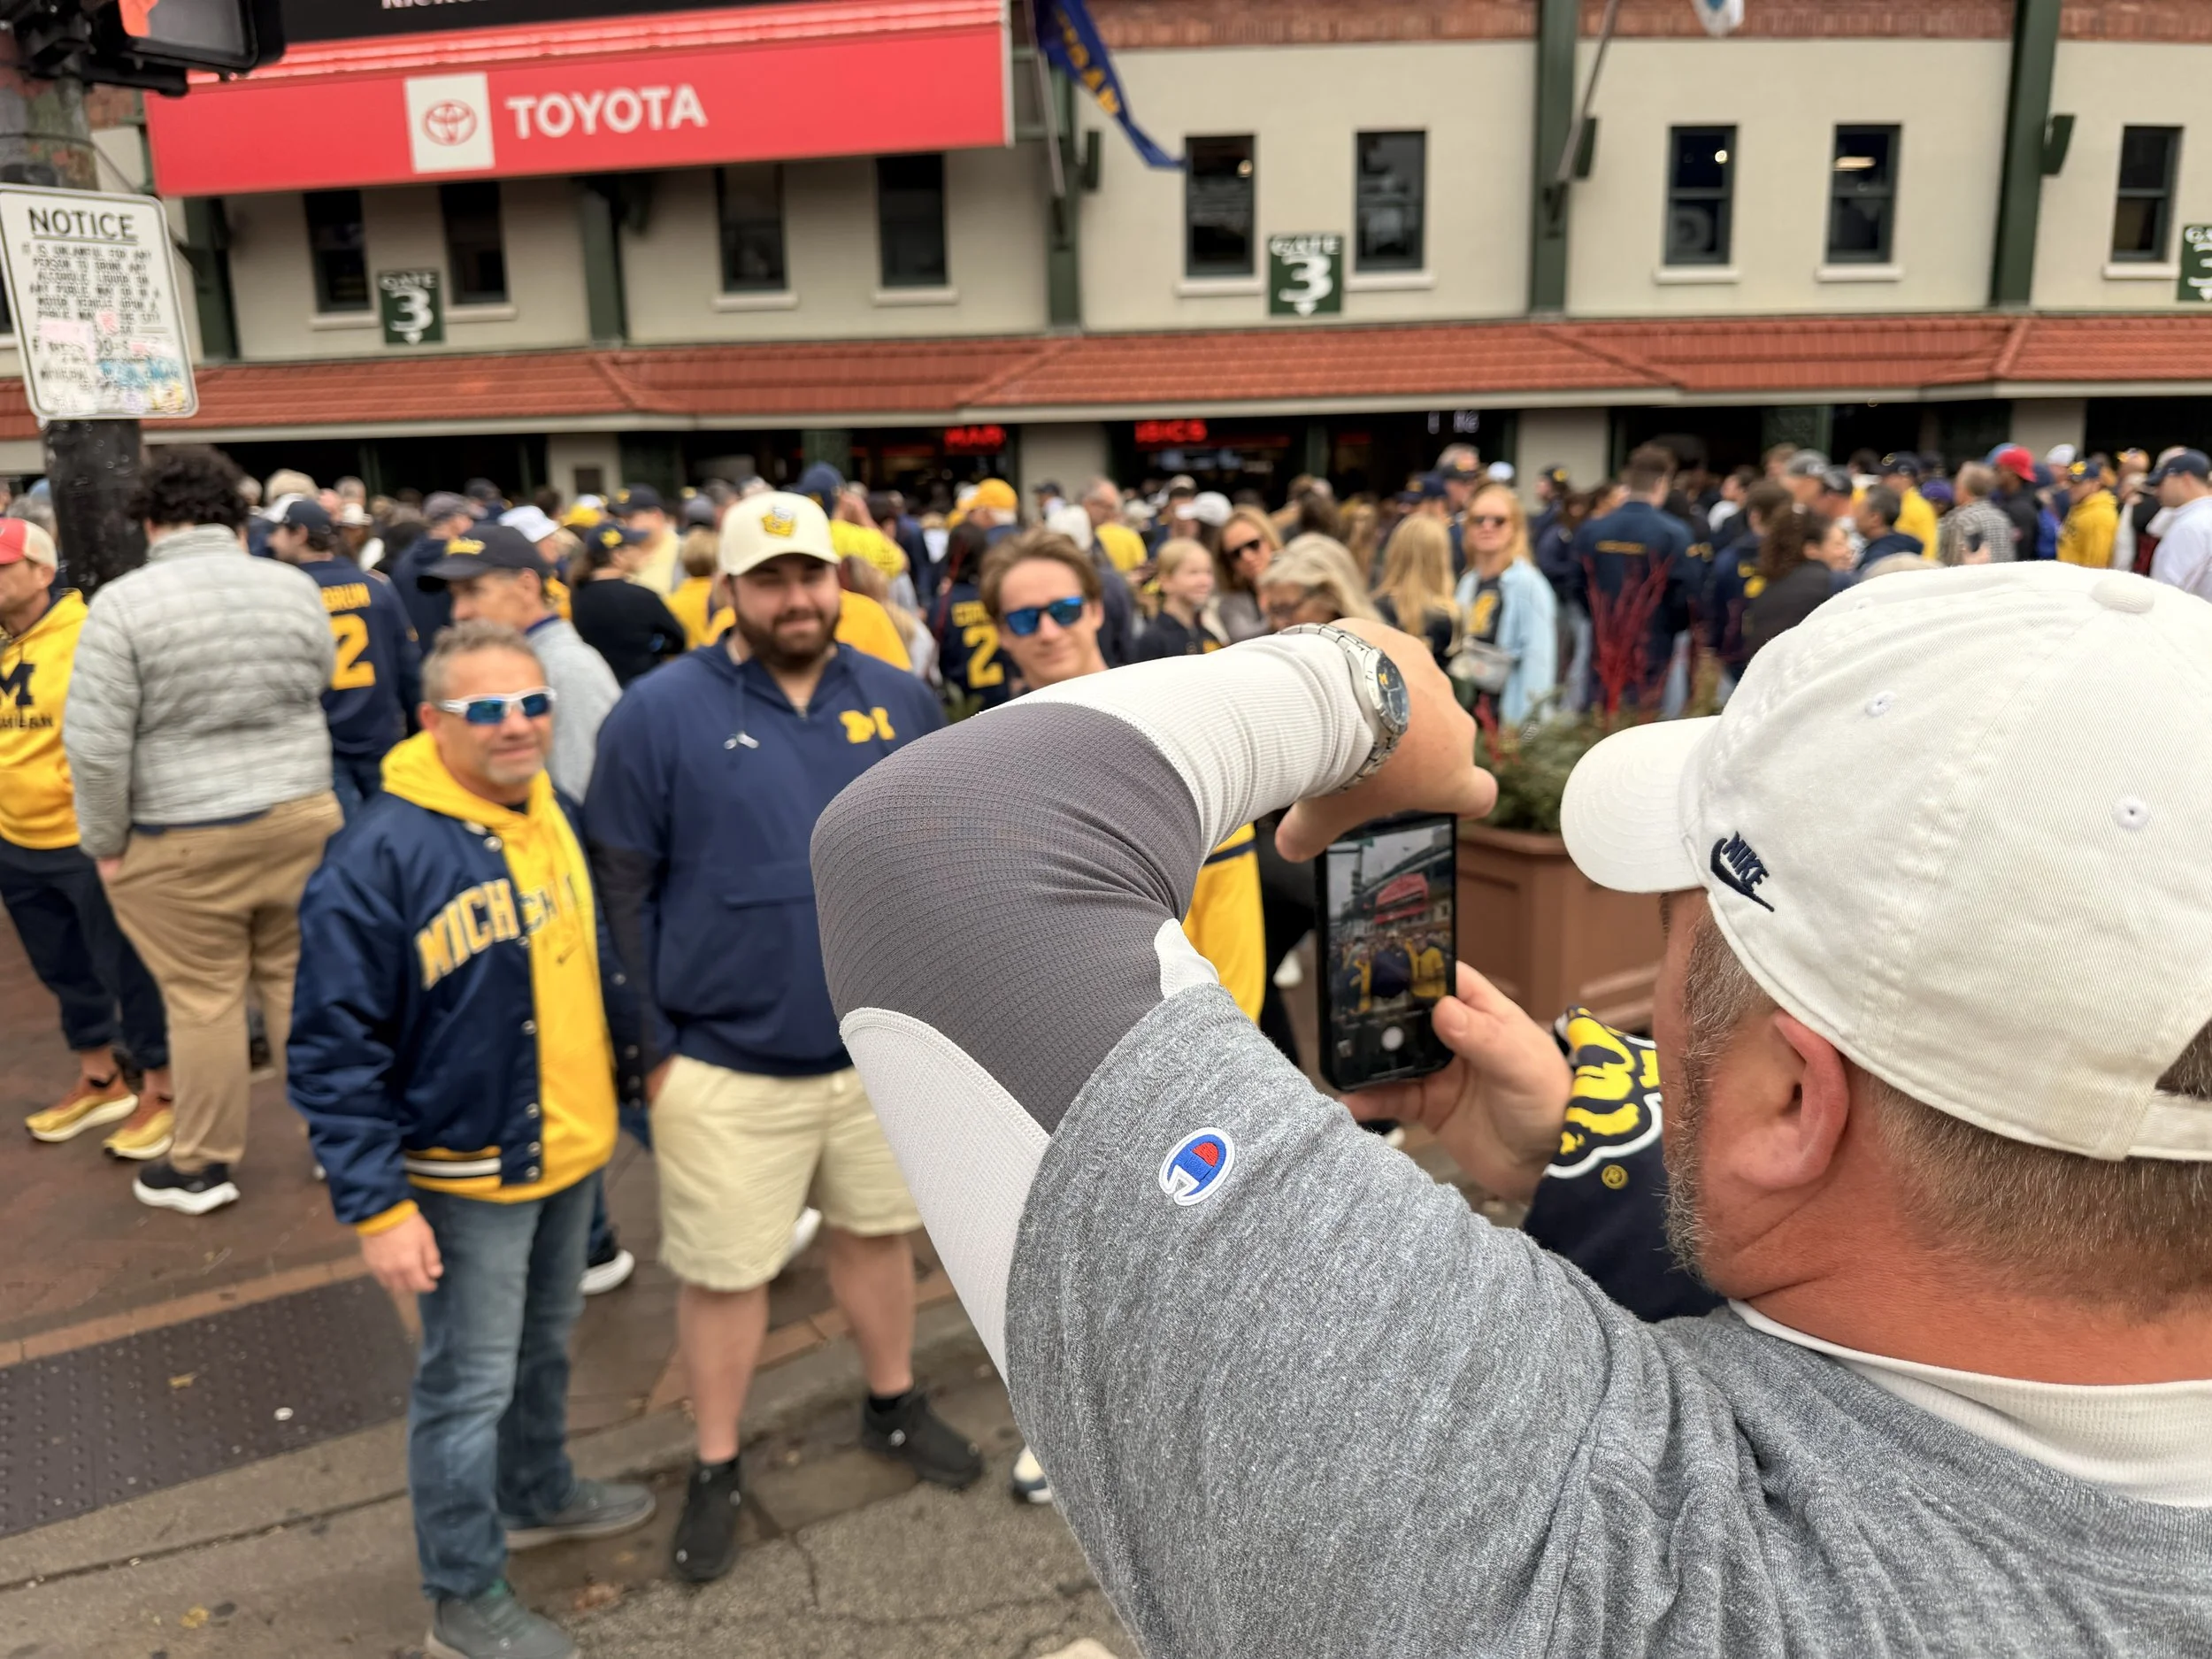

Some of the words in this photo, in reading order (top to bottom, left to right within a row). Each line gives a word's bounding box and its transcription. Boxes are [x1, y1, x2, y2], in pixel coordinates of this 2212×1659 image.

[503, 83, 708, 140] TOYOTA
[27, 207, 137, 239] NOTICE
[1270, 236, 1340, 257] GATE
[1279, 255, 1333, 302] 3
[388, 288, 434, 332] 3
[329, 614, 375, 689] 2
[963, 625, 1004, 688] 2
[1722, 830, 1770, 894] NIKE
